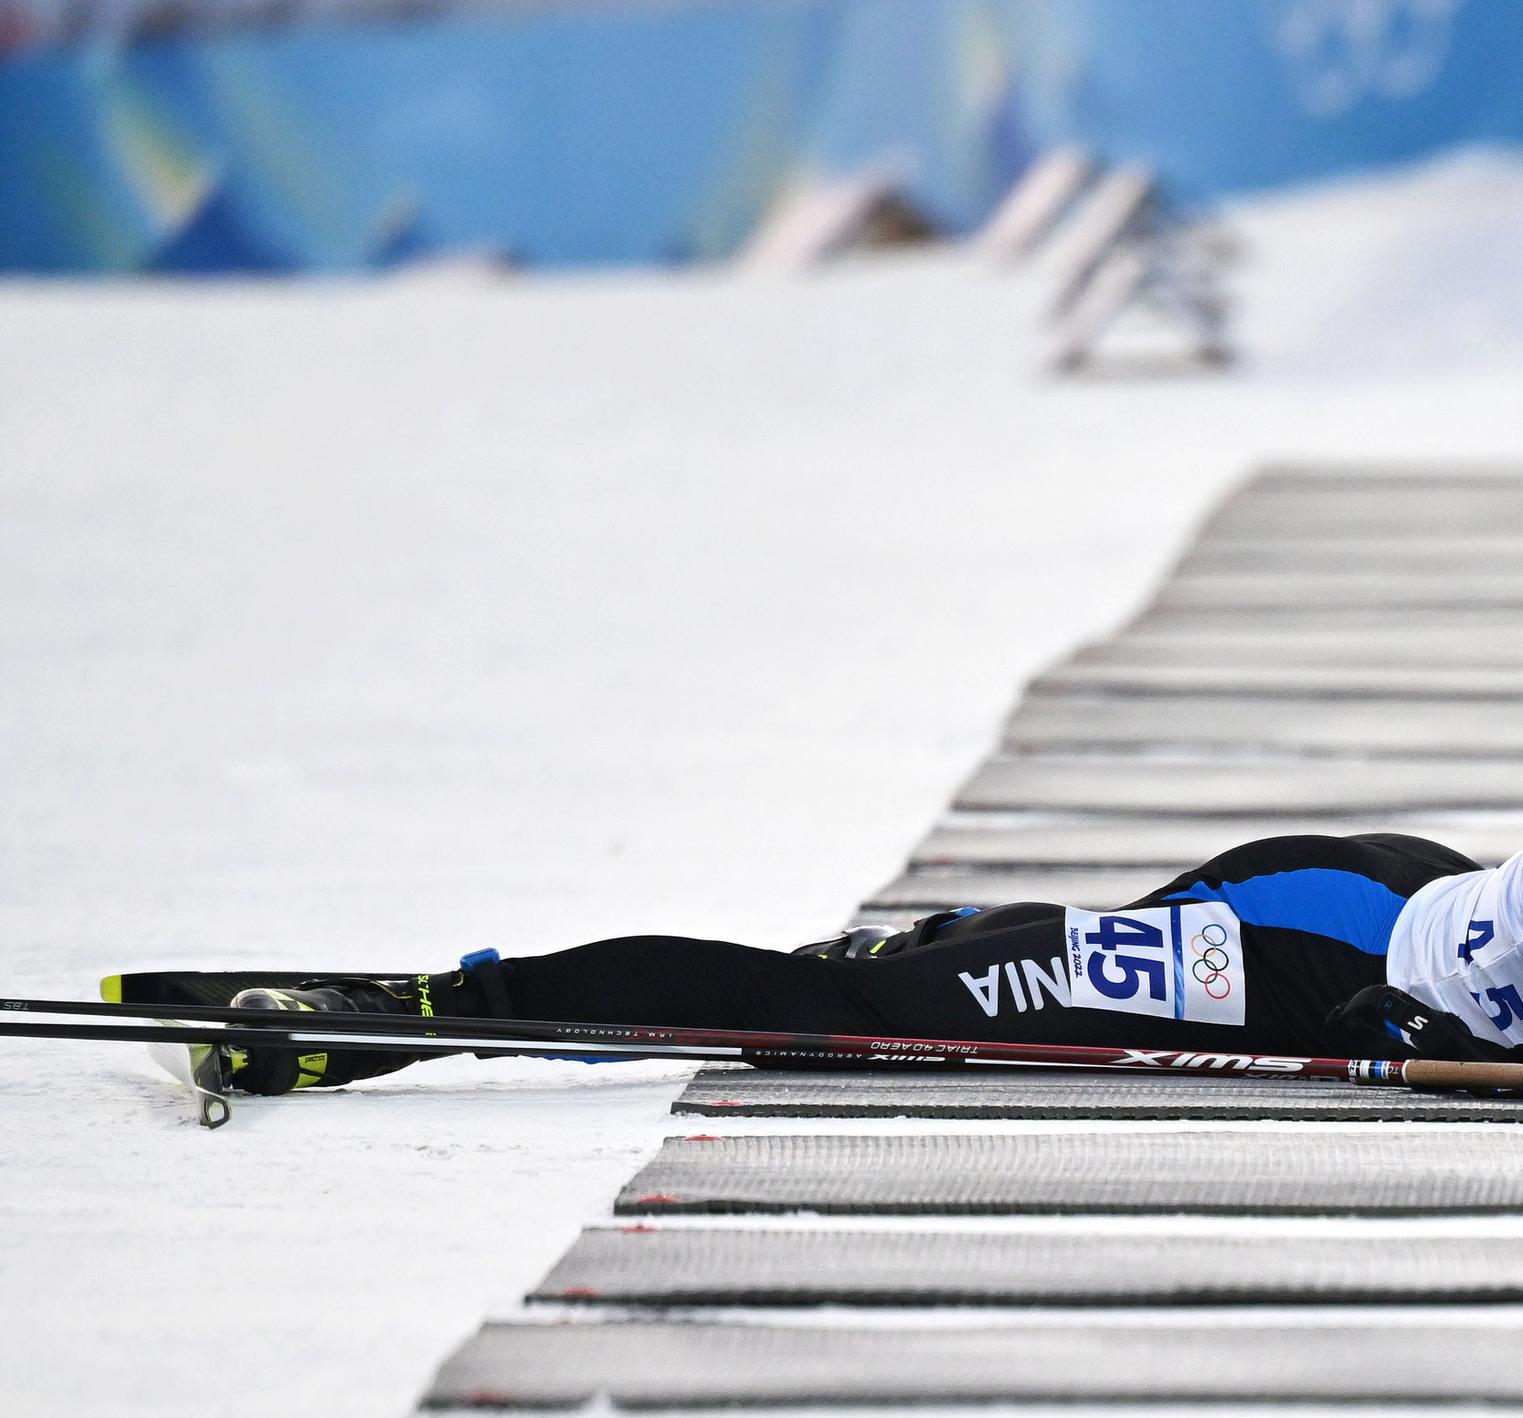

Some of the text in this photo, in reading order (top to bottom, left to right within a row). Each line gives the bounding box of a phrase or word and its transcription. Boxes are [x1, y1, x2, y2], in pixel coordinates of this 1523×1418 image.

[1068, 927, 1083, 979] BEIJING 2022
[1084, 915, 1167, 1002] 45
[957, 955, 1073, 1018] NIA
[870, 1041, 912, 1051] AERO
[935, 1044, 978, 1054] TRIAC
